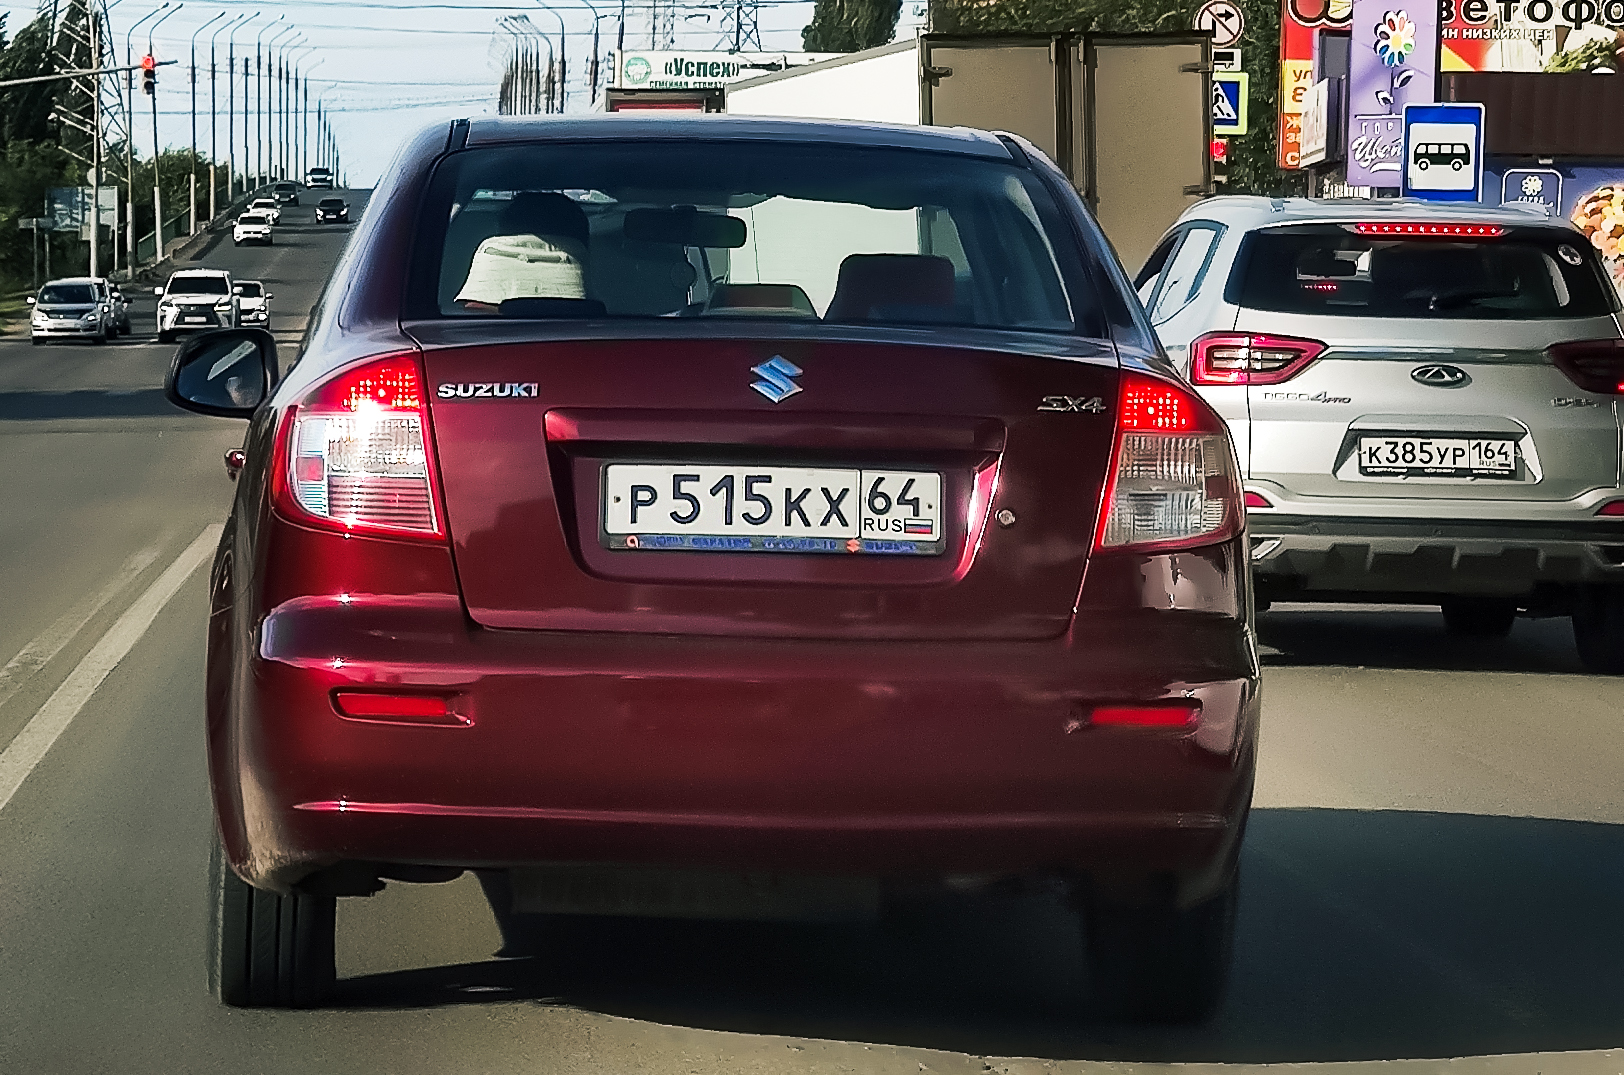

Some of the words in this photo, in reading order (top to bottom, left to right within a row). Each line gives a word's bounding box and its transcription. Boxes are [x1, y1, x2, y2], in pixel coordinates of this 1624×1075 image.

[1463, 28, 1520, 40] НИЗКИХ
[1524, 28, 1554, 42] ЦЕН
[664, 57, 740, 78] «Успех»
[437, 382, 539, 399] SUZUKI
[1037, 395, 1107, 414] SX4
[1367, 441, 1466, 465] К385УР
[1471, 441, 1510, 461] 164
[1479, 460, 1497, 468] RUS
[629, 474, 850, 528] Р515КХ
[867, 476, 920, 517] 64
[863, 518, 903, 533] RUS
